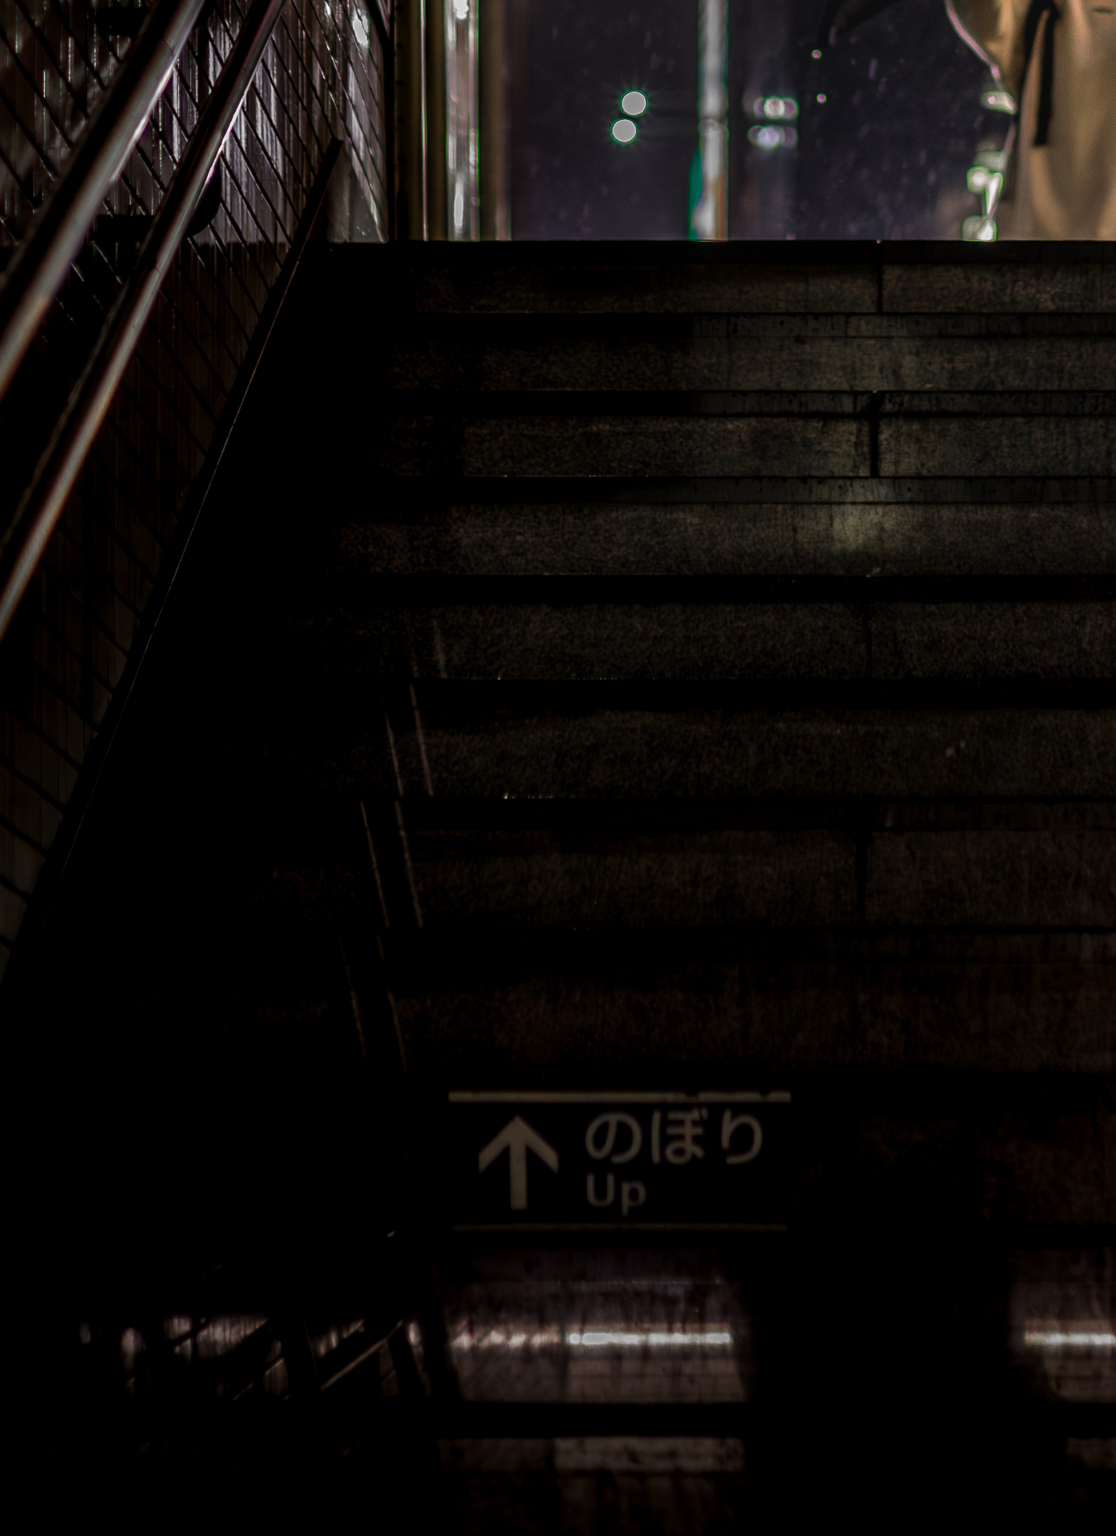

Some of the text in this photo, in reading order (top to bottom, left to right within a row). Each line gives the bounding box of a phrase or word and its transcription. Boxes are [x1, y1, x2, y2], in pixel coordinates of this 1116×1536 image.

[584, 1105, 765, 1166] のぼり
[585, 1169, 649, 1219] Up
